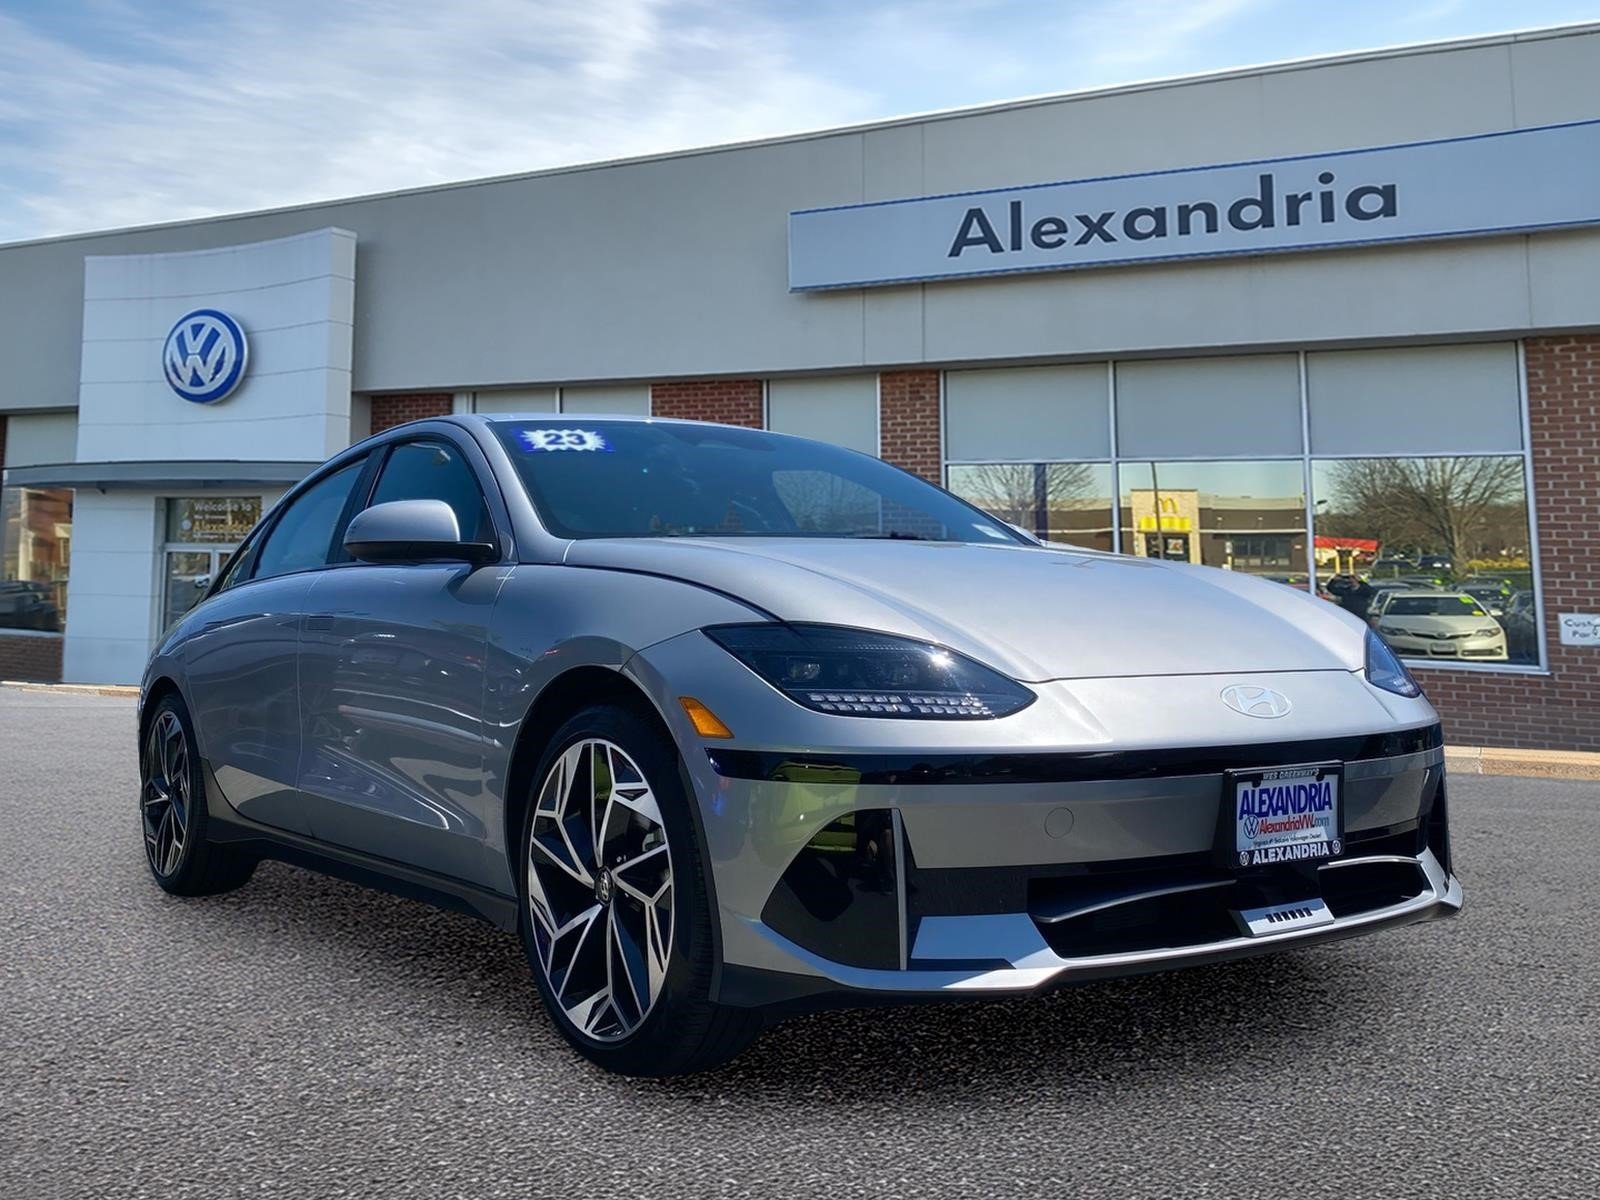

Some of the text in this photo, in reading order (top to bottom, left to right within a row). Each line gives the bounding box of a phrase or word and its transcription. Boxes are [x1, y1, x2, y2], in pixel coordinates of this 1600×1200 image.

[947, 171, 1398, 259] Alexandria
[165, 314, 237, 395] VW
[543, 433, 588, 446] 23
[194, 502, 253, 512] Welcome to
[1238, 782, 1333, 820] ALEXANDRIA
[1260, 814, 1330, 835] AlexandriaVW.com
[1253, 842, 1330, 865] ALEXANDRIA
